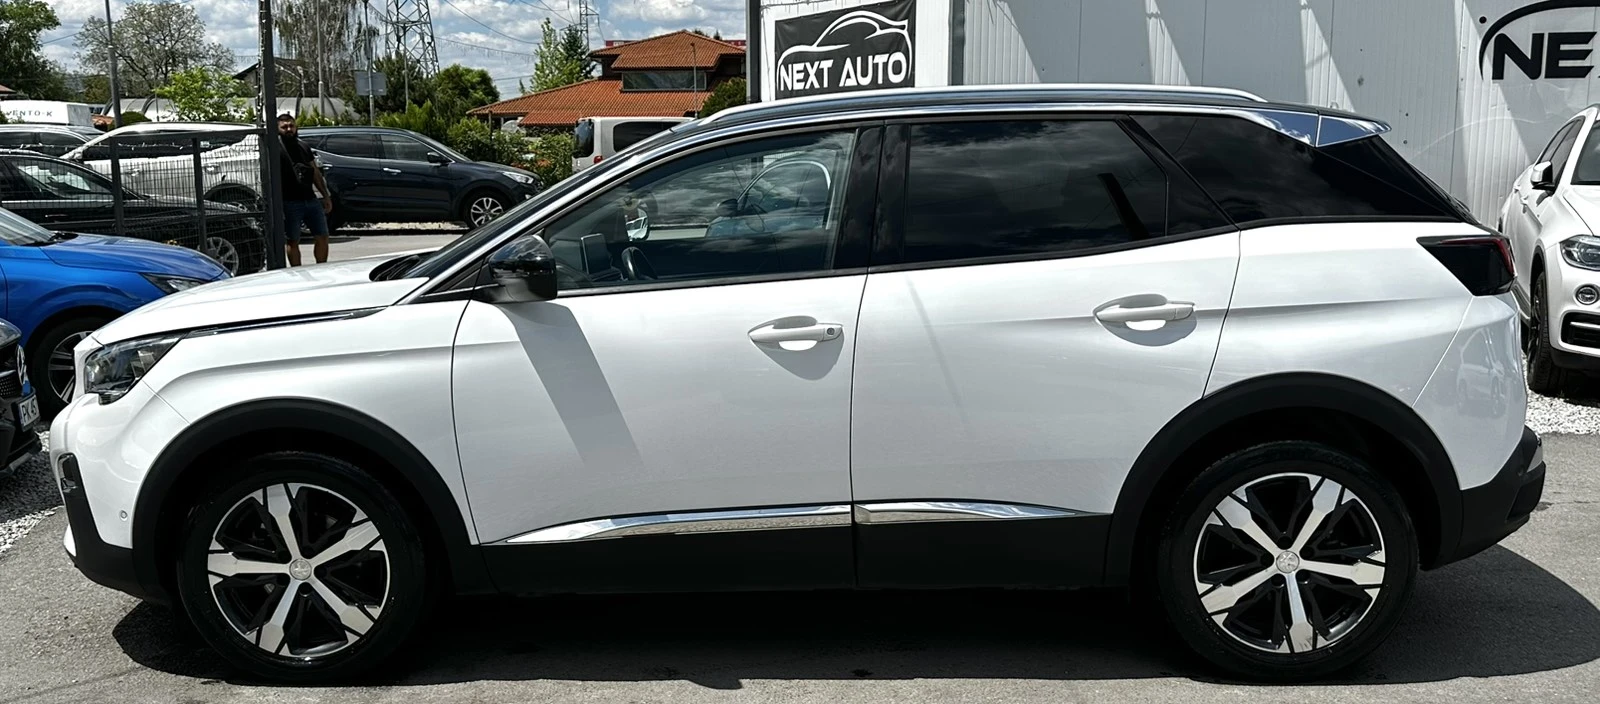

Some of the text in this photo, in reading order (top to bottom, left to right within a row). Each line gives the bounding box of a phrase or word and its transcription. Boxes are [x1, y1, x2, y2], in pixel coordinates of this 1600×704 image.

[780, 51, 908, 91] NEXT AUTO
[1491, 31, 1600, 80] NE
